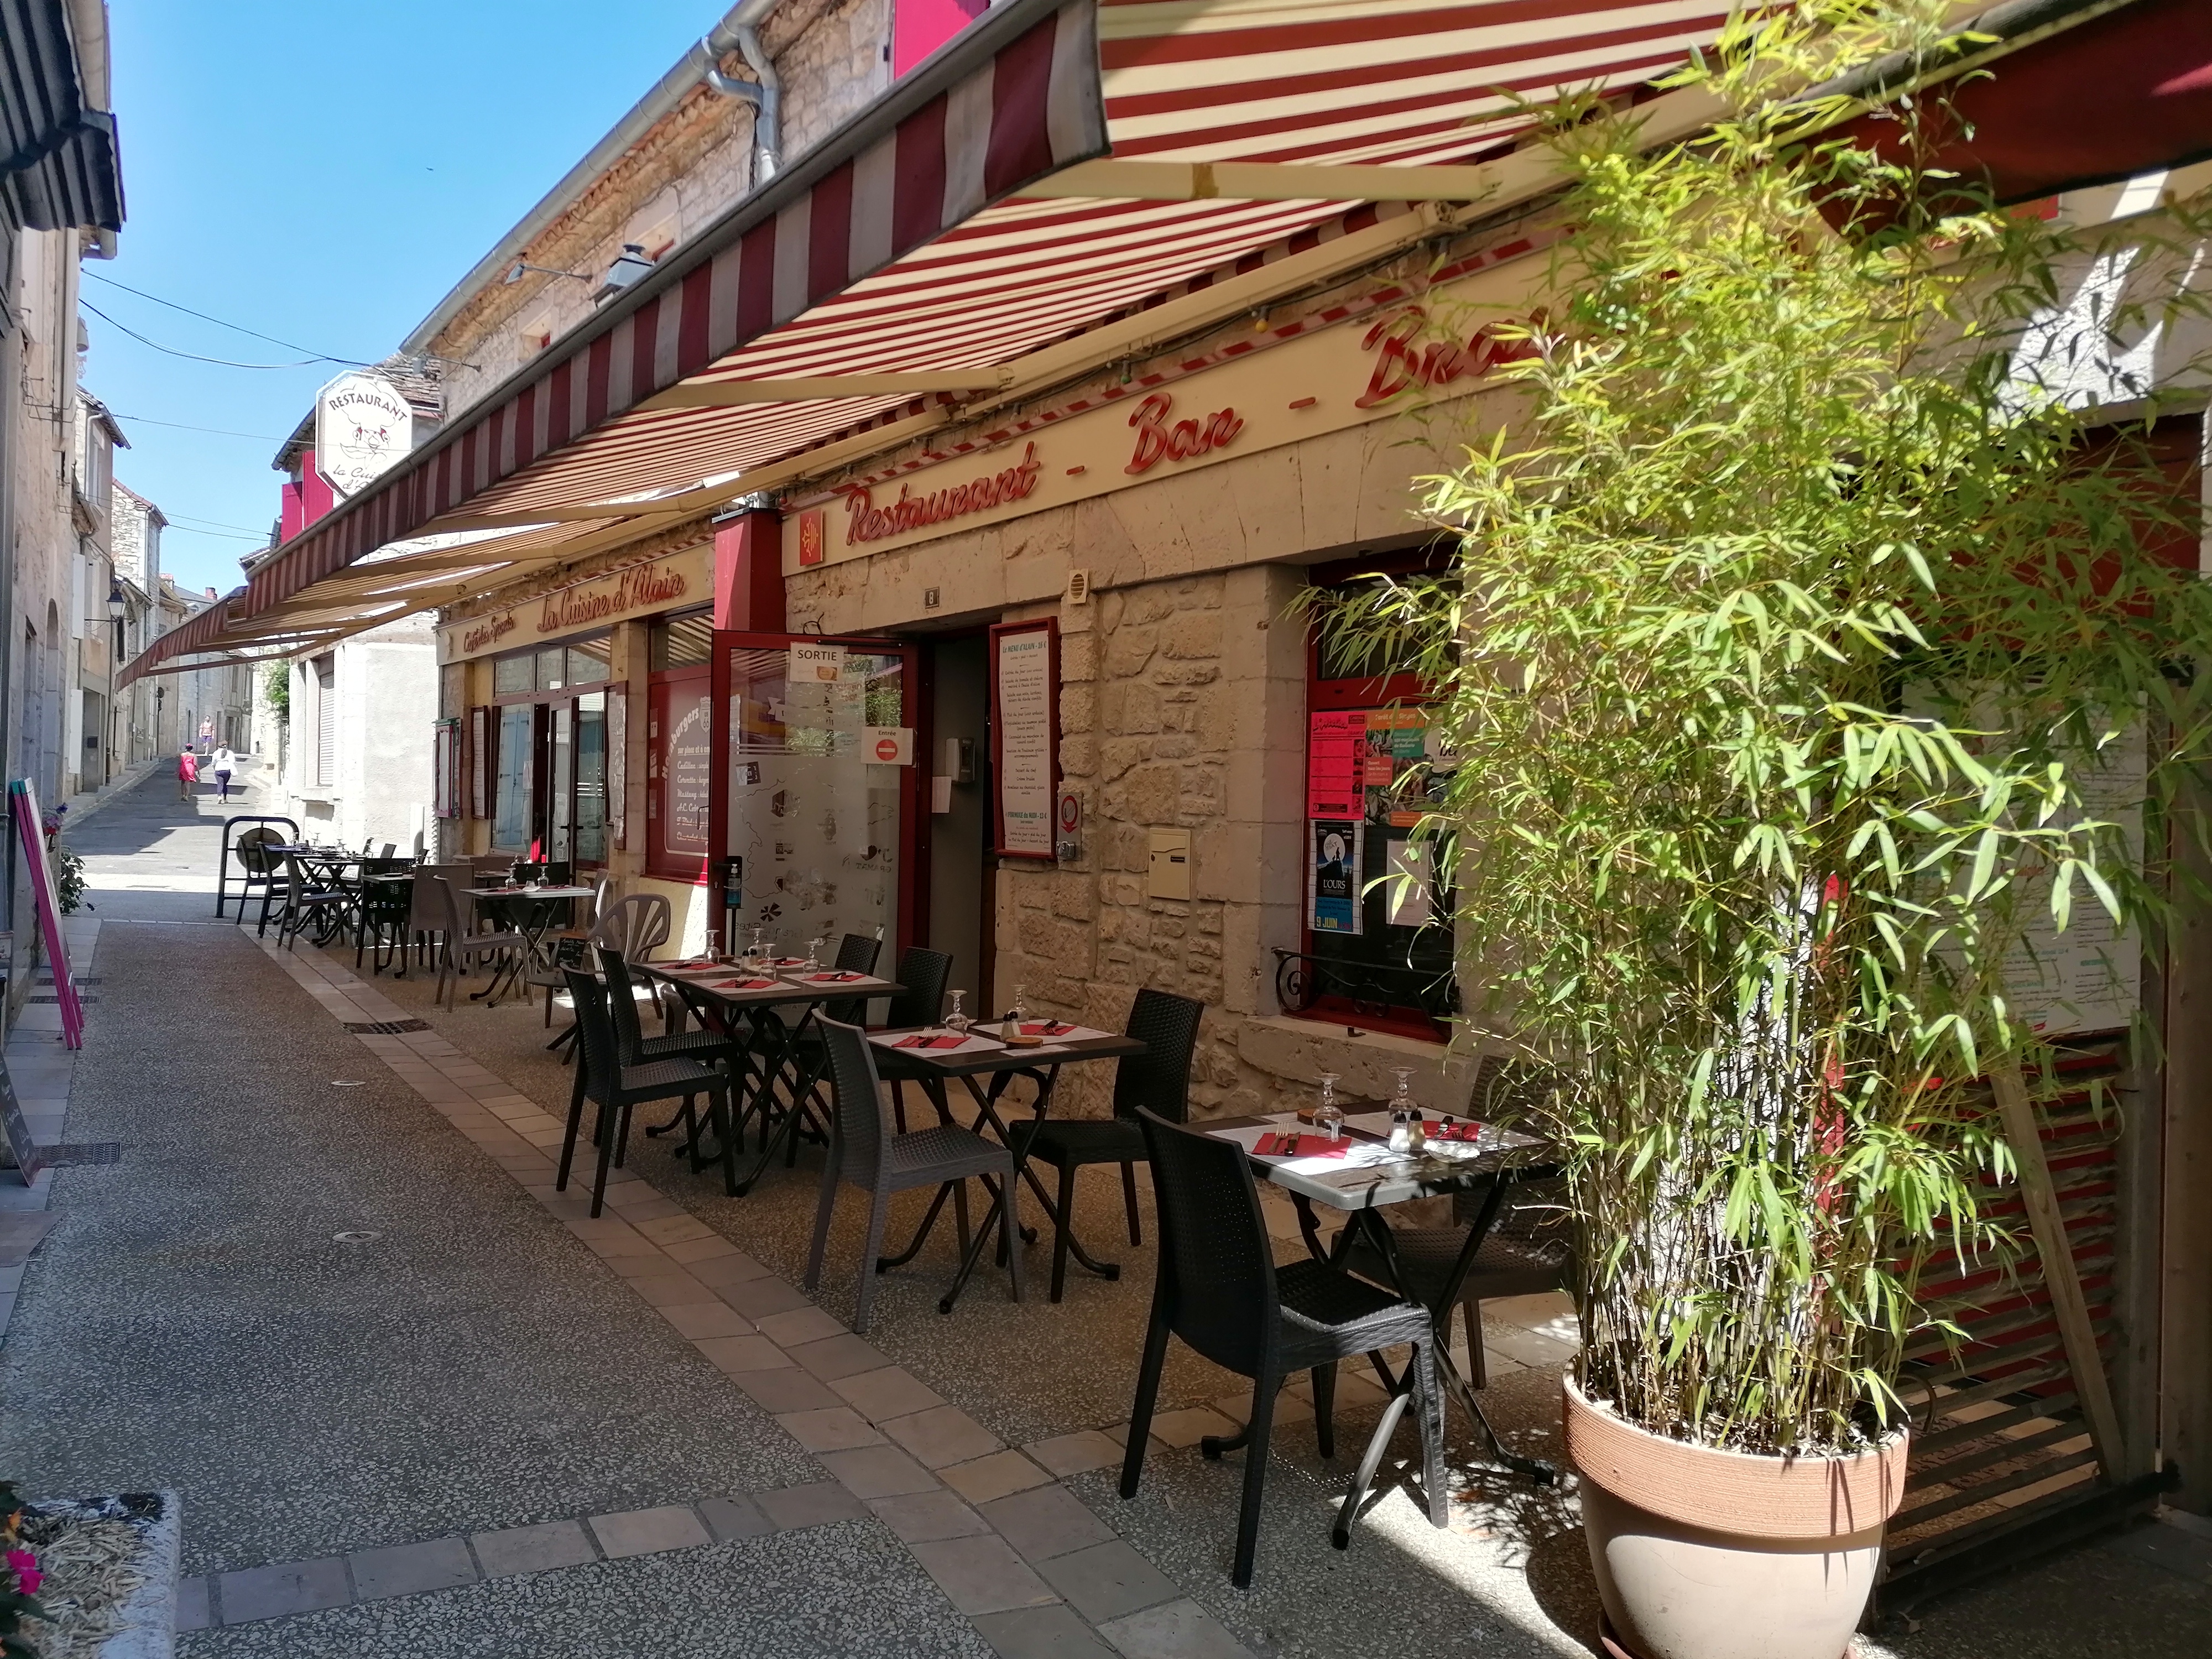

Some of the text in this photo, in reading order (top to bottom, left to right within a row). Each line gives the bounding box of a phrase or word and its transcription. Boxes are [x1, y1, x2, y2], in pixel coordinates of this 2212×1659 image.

[328, 393, 407, 421] RESTAURANT
[844, 441, 1041, 546] Restaurant
[1124, 392, 1244, 475] Bar
[536, 564, 685, 633] La Cuisine d'Alain
[928, 591, 934, 605] 8
[490, 610, 517, 644] Sports
[1020, 643, 1035, 651] d'ALAIN
[797, 649, 837, 661] SORTIE
[661, 707, 700, 780] Hamburgers
[684, 745, 695, 757] place
[677, 760, 696, 769] Cadillac
[677, 775, 697, 784] Corvette
[677, 789, 697, 800] Mustang
[1323, 879, 1346, 890] L'OURS
[1316, 916, 1321, 927] 9
[1322, 917, 1338, 929] JUIN
